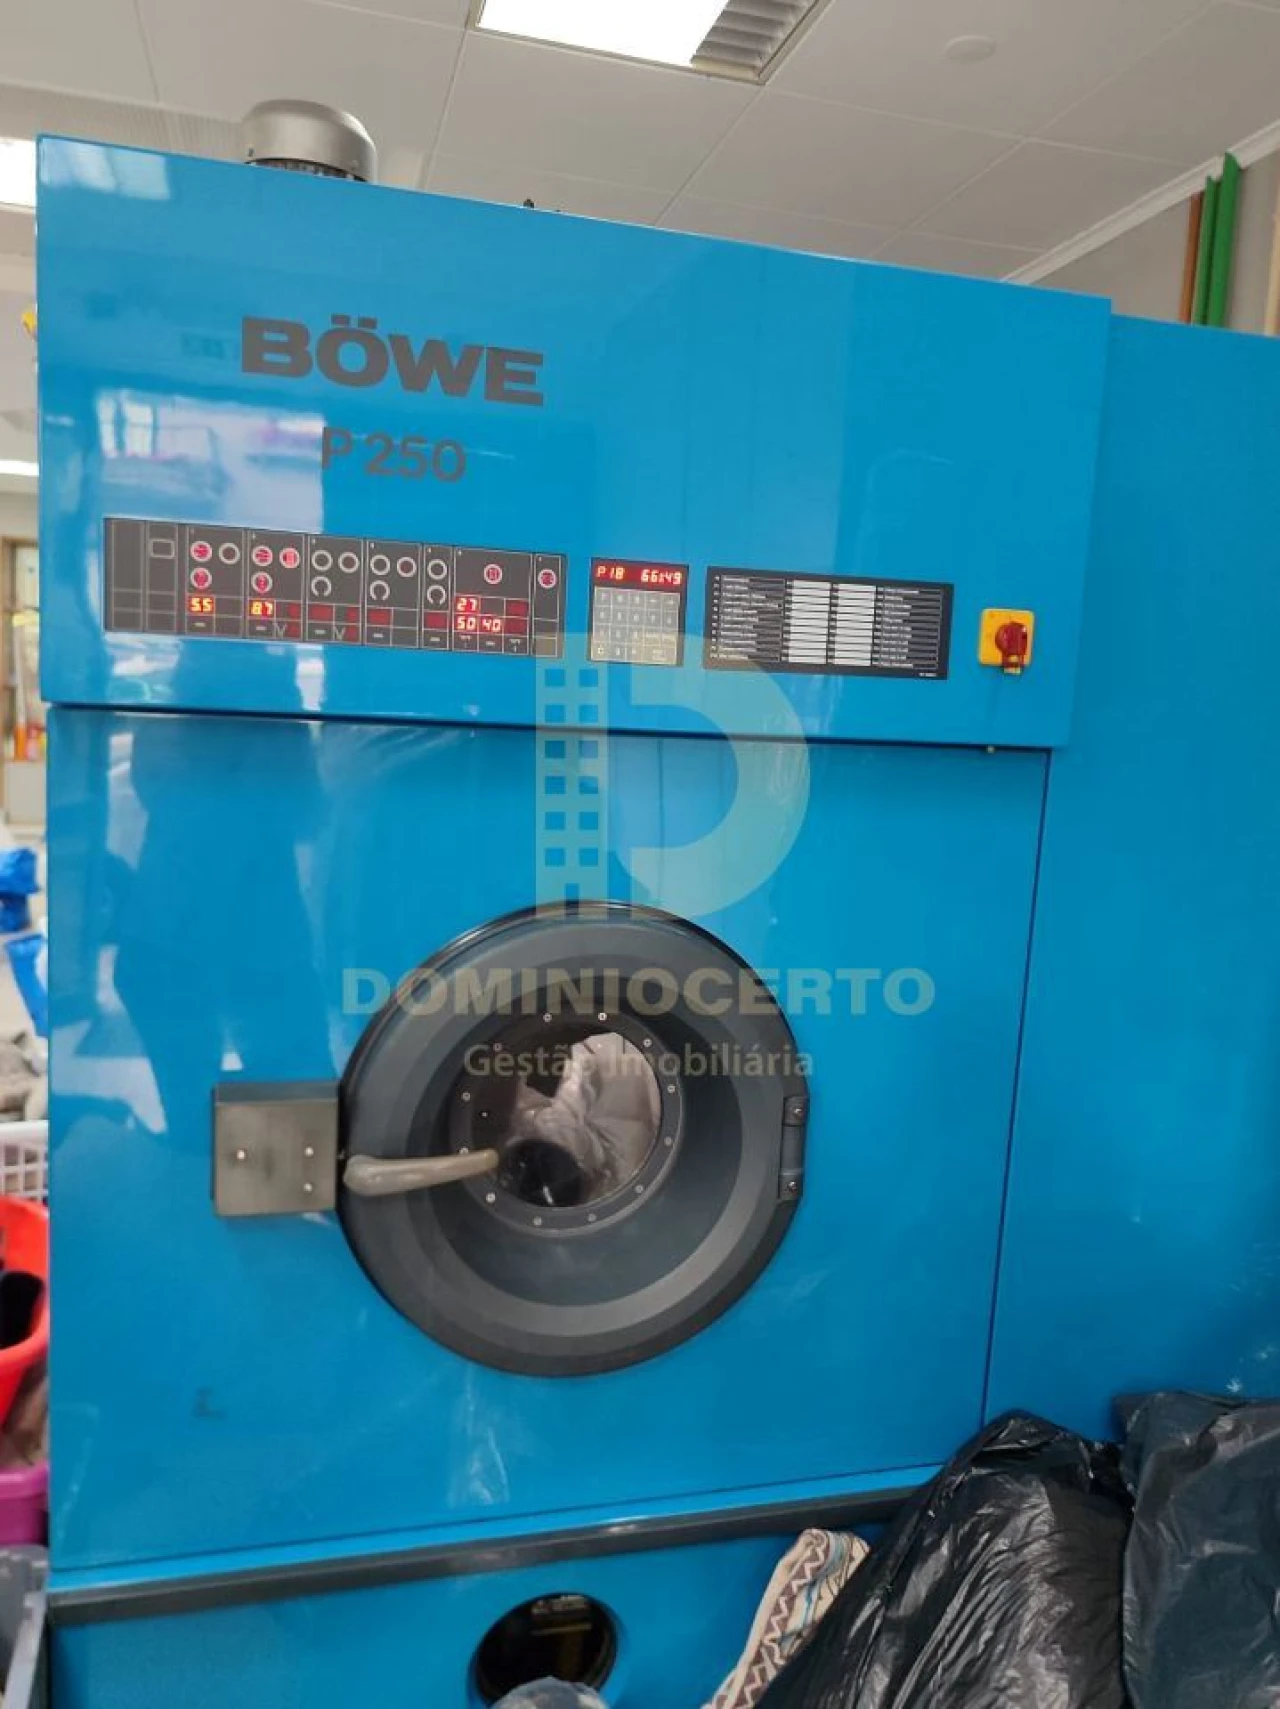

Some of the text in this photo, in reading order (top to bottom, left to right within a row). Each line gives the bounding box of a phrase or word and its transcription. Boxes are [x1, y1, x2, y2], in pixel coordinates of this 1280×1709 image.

[241, 313, 544, 407] BÖWE
[321, 426, 467, 483] P 250
[456, 597, 478, 613] 27
[456, 615, 502, 632] 50 40
